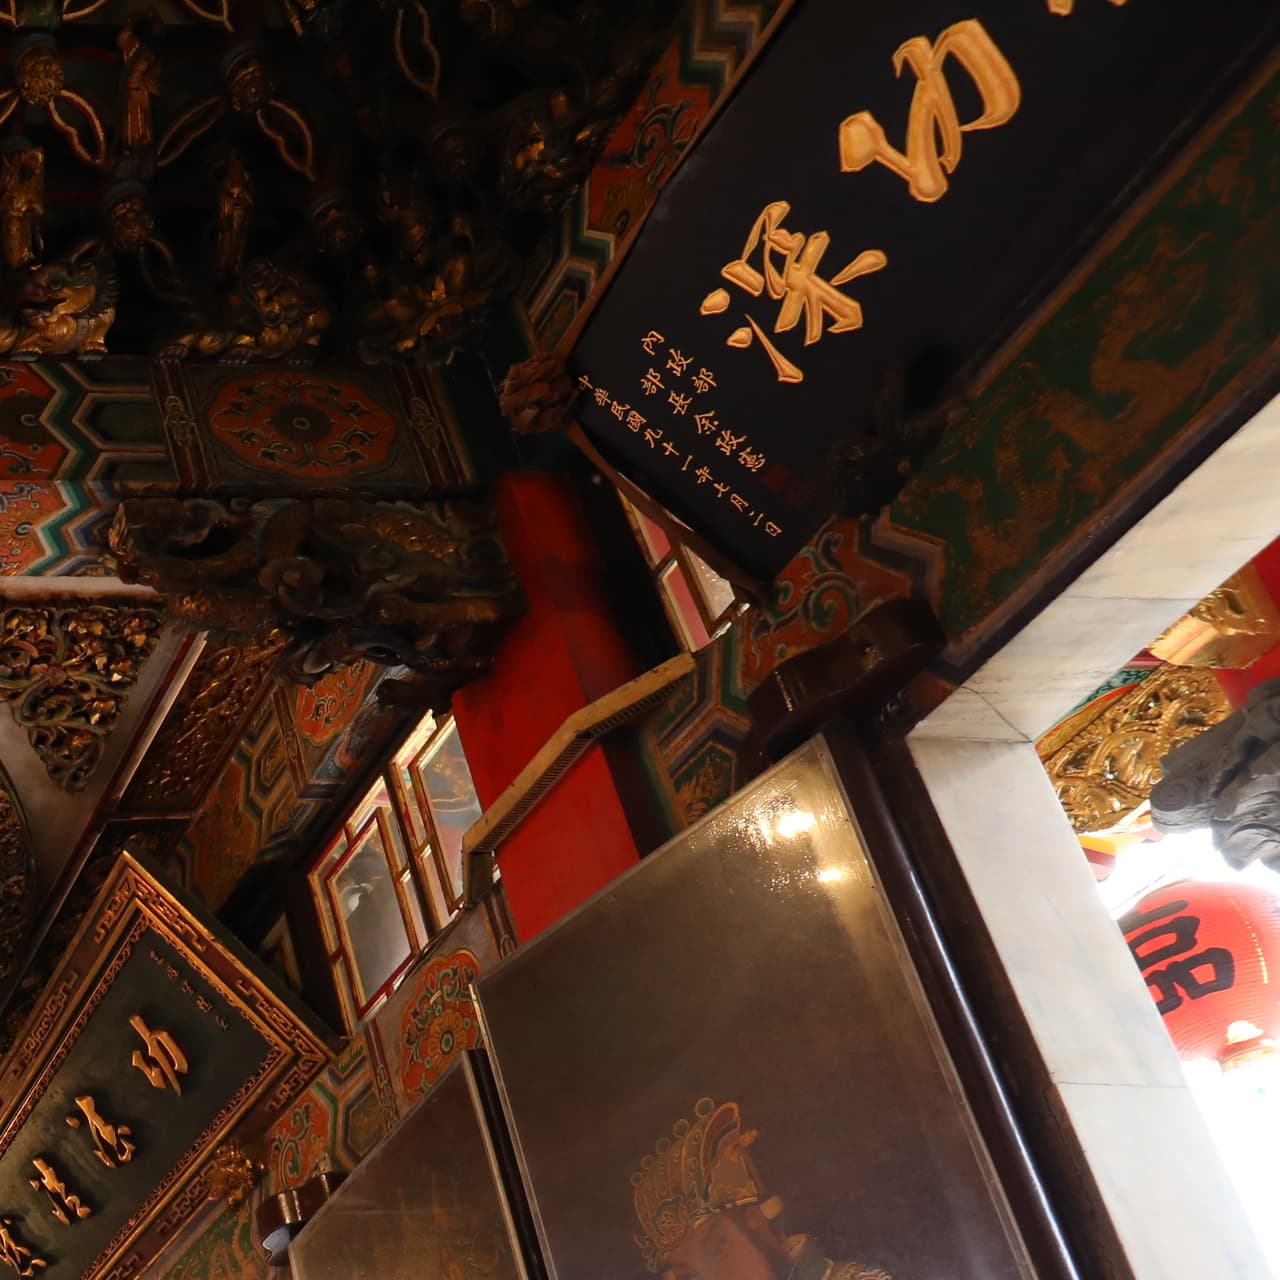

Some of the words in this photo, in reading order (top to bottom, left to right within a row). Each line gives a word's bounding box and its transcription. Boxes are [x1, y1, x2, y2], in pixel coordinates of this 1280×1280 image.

[639, 329, 718, 395] 內政部
[577, 374, 783, 538] 中華民國九十一年七月二日
[641, 367, 766, 473] 部長余政憲
